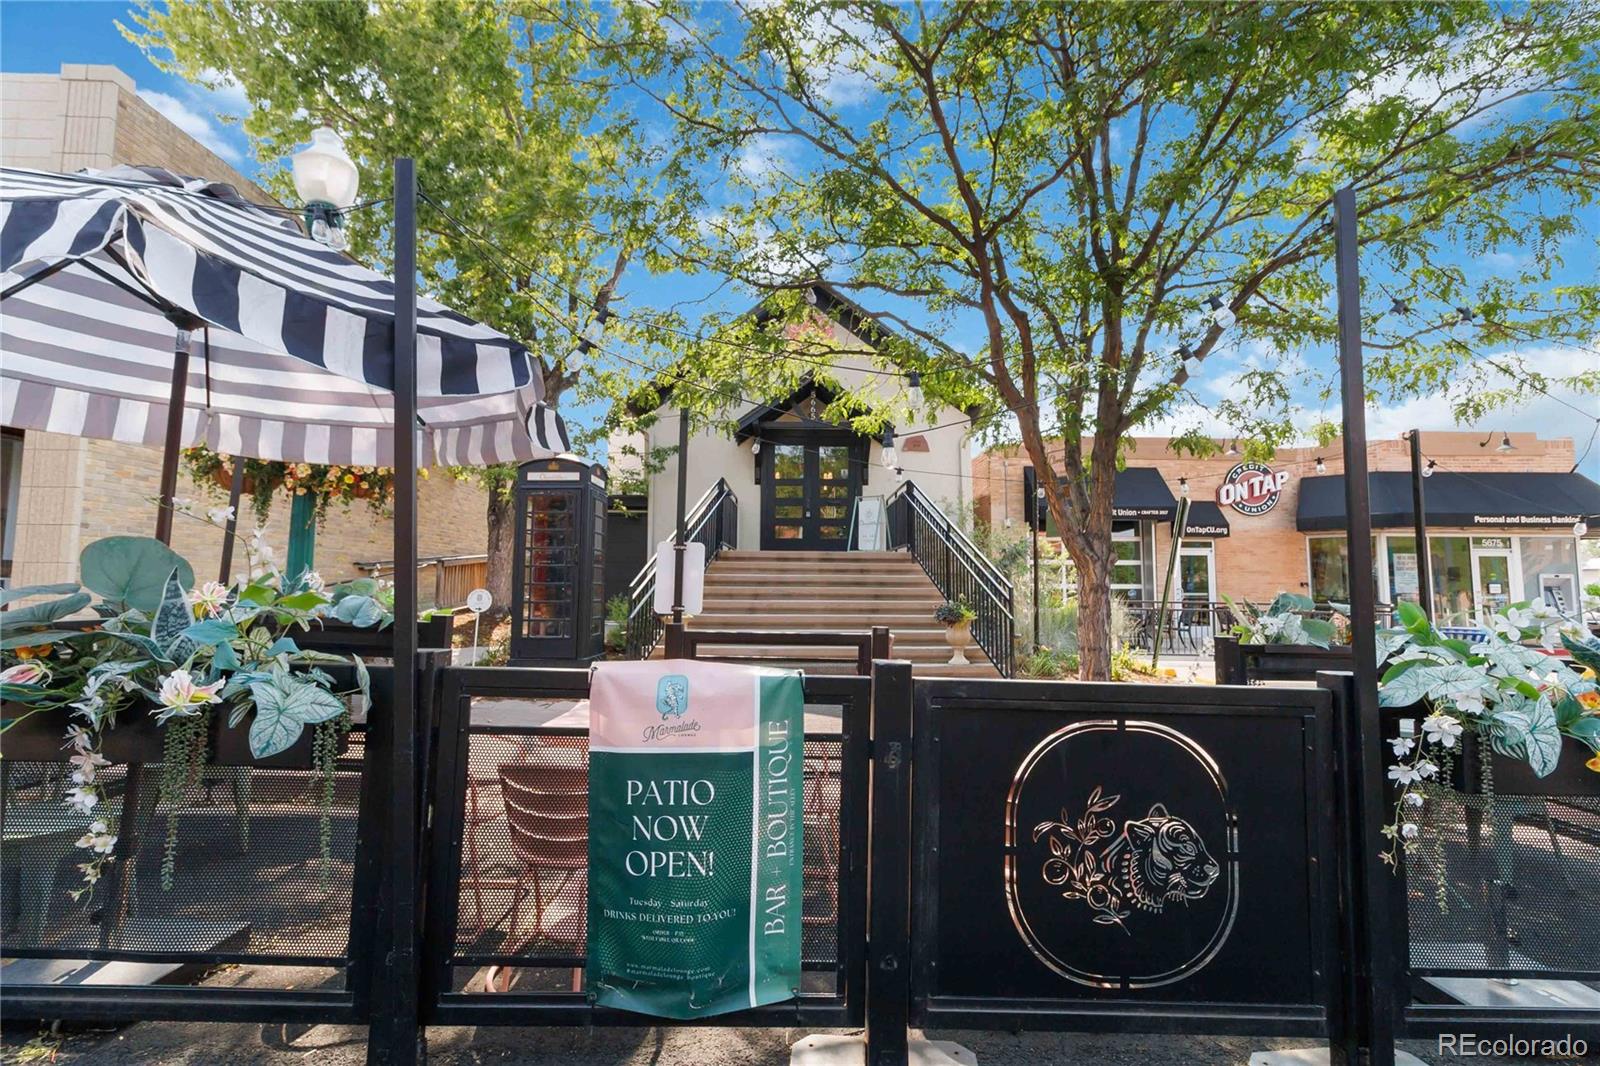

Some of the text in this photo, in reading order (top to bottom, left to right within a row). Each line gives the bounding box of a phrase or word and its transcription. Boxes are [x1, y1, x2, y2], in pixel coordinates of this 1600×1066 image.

[1117, 508, 1137, 516] Union
[1244, 500, 1273, 513] UNION
[1474, 515, 1505, 523] Personal
[1482, 538, 1502, 547] 5675
[642, 719, 701, 742] Marmalade
[627, 780, 715, 806] PATIO
[767, 719, 792, 858] BOUTIQUE
[632, 815, 710, 841] NOW
[625, 850, 714, 878] OPEN!
[629, 897, 709, 911] Tuesday Saturday
[764, 884, 787, 937] BAR
[603, 908, 637, 921] DRINKS
[639, 913, 694, 924] DELIVERED
